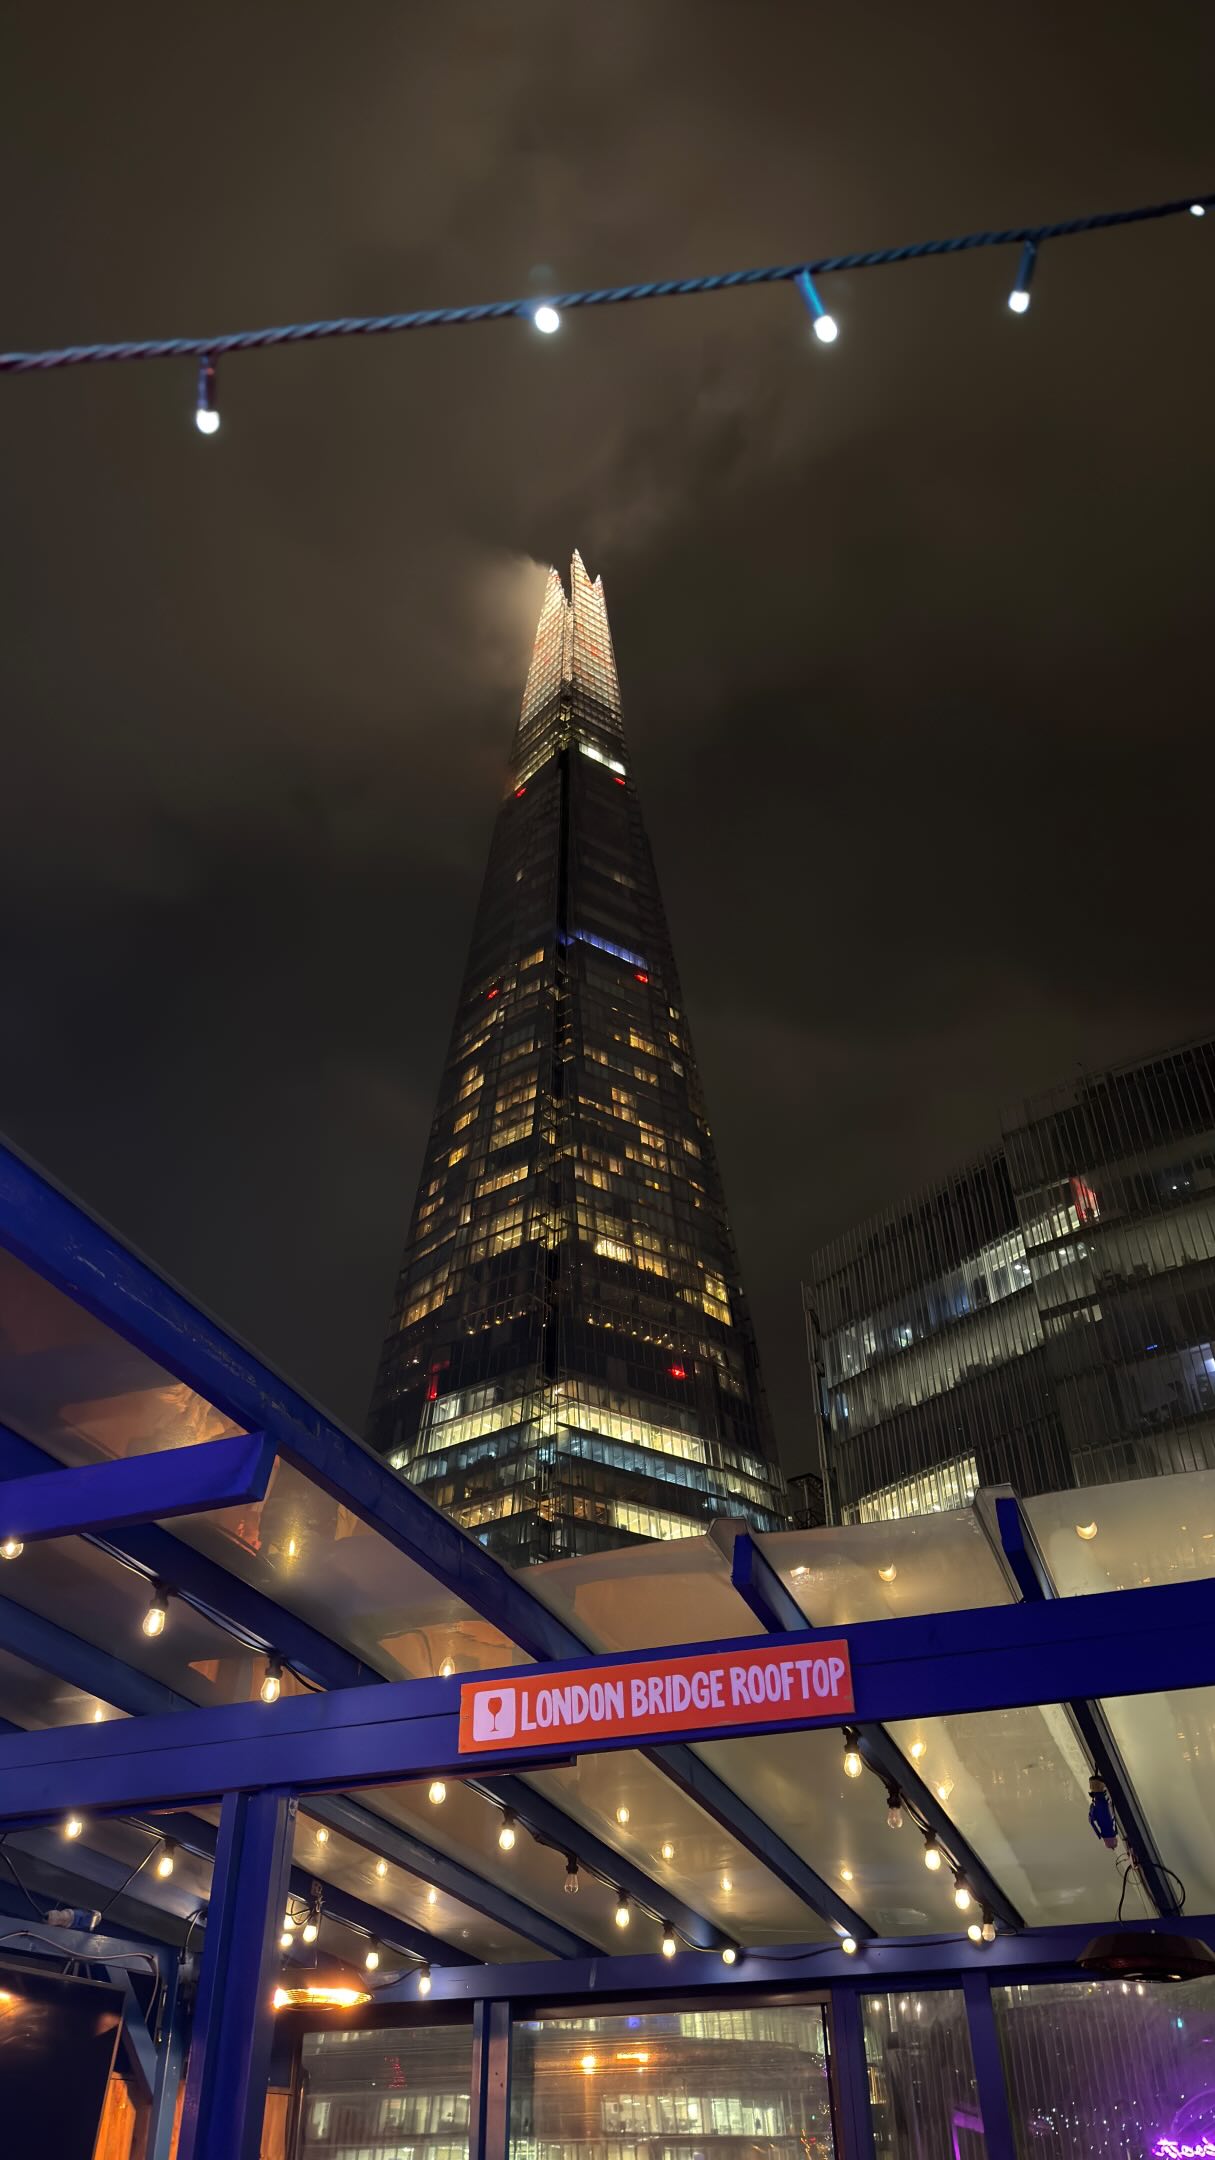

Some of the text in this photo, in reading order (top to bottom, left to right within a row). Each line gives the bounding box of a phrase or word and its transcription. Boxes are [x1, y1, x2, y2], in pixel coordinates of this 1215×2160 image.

[521, 1658, 845, 1731] LONDON BRIDGE ROOFTOP
